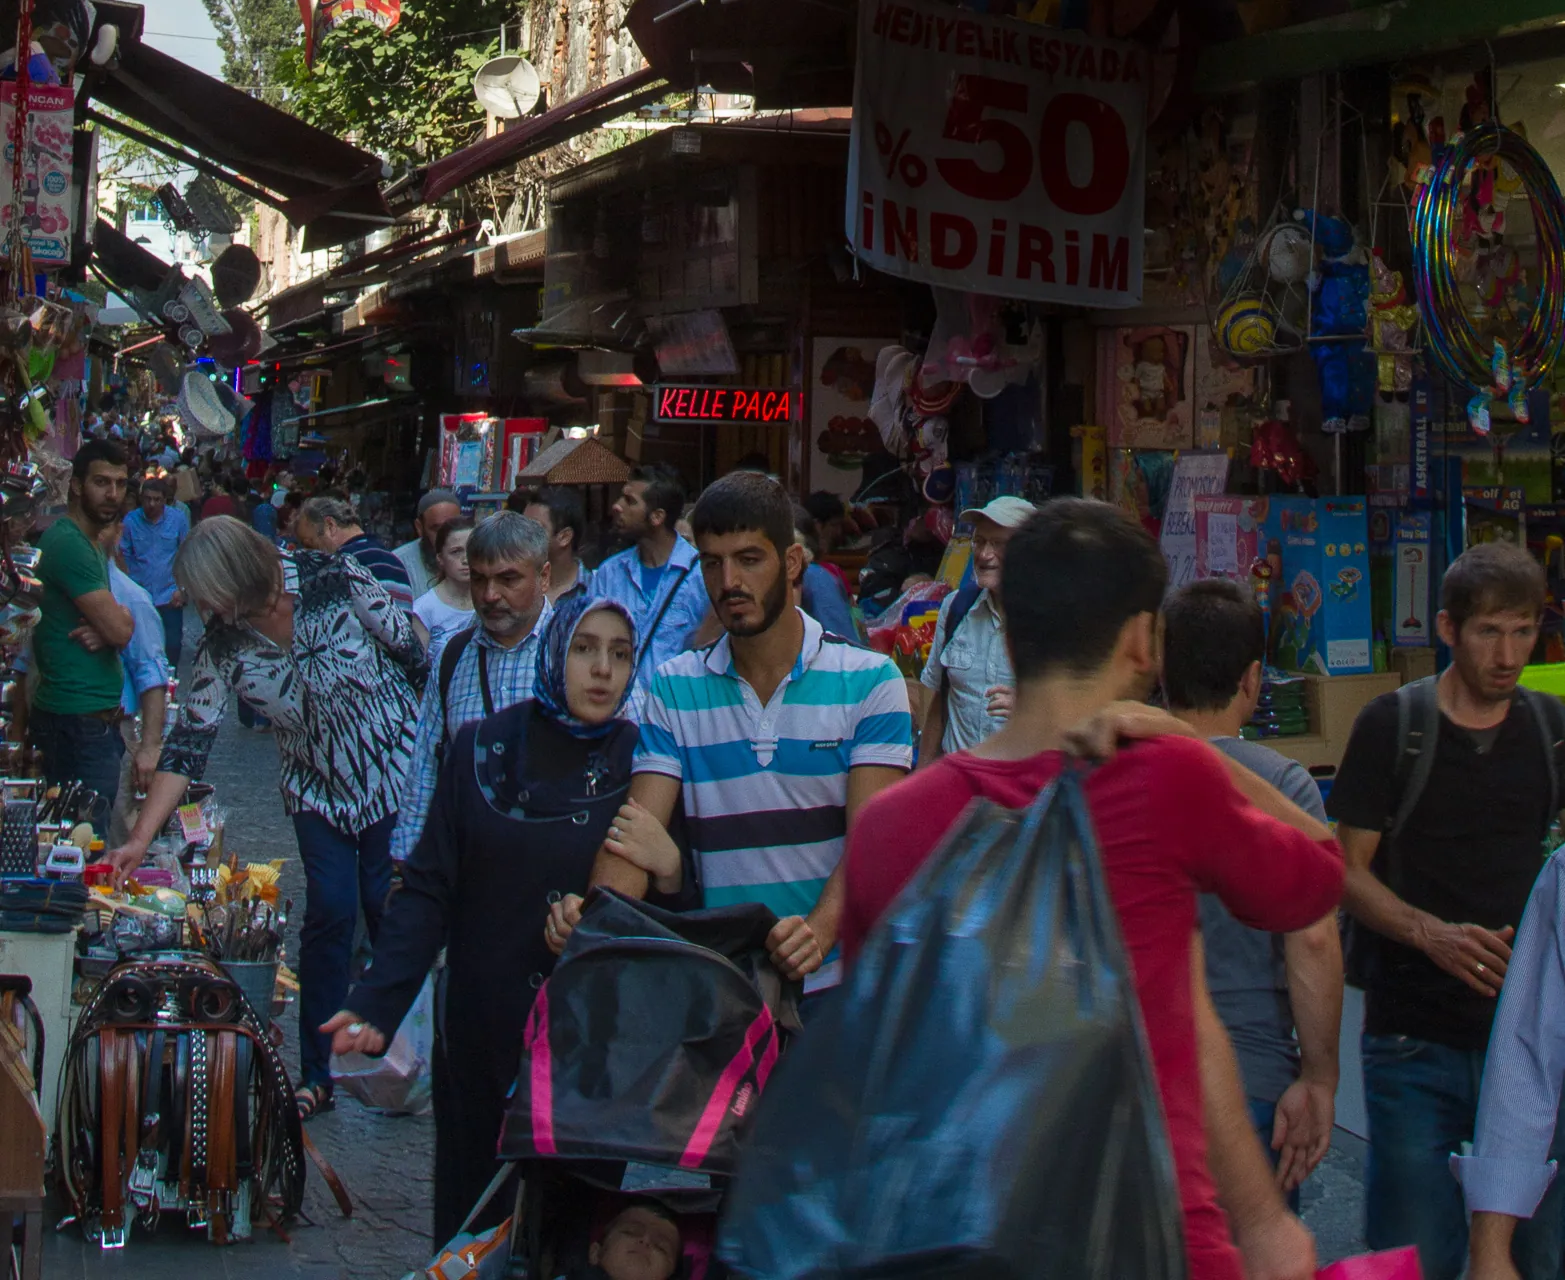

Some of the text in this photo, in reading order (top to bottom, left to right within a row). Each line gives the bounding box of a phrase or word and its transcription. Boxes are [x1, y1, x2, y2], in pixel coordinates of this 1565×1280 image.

[1028, 34, 1142, 83] EŞYADA
[862, 190, 1130, 292] İNDİRİM
[659, 388, 790, 422] KELLE PAÇA
